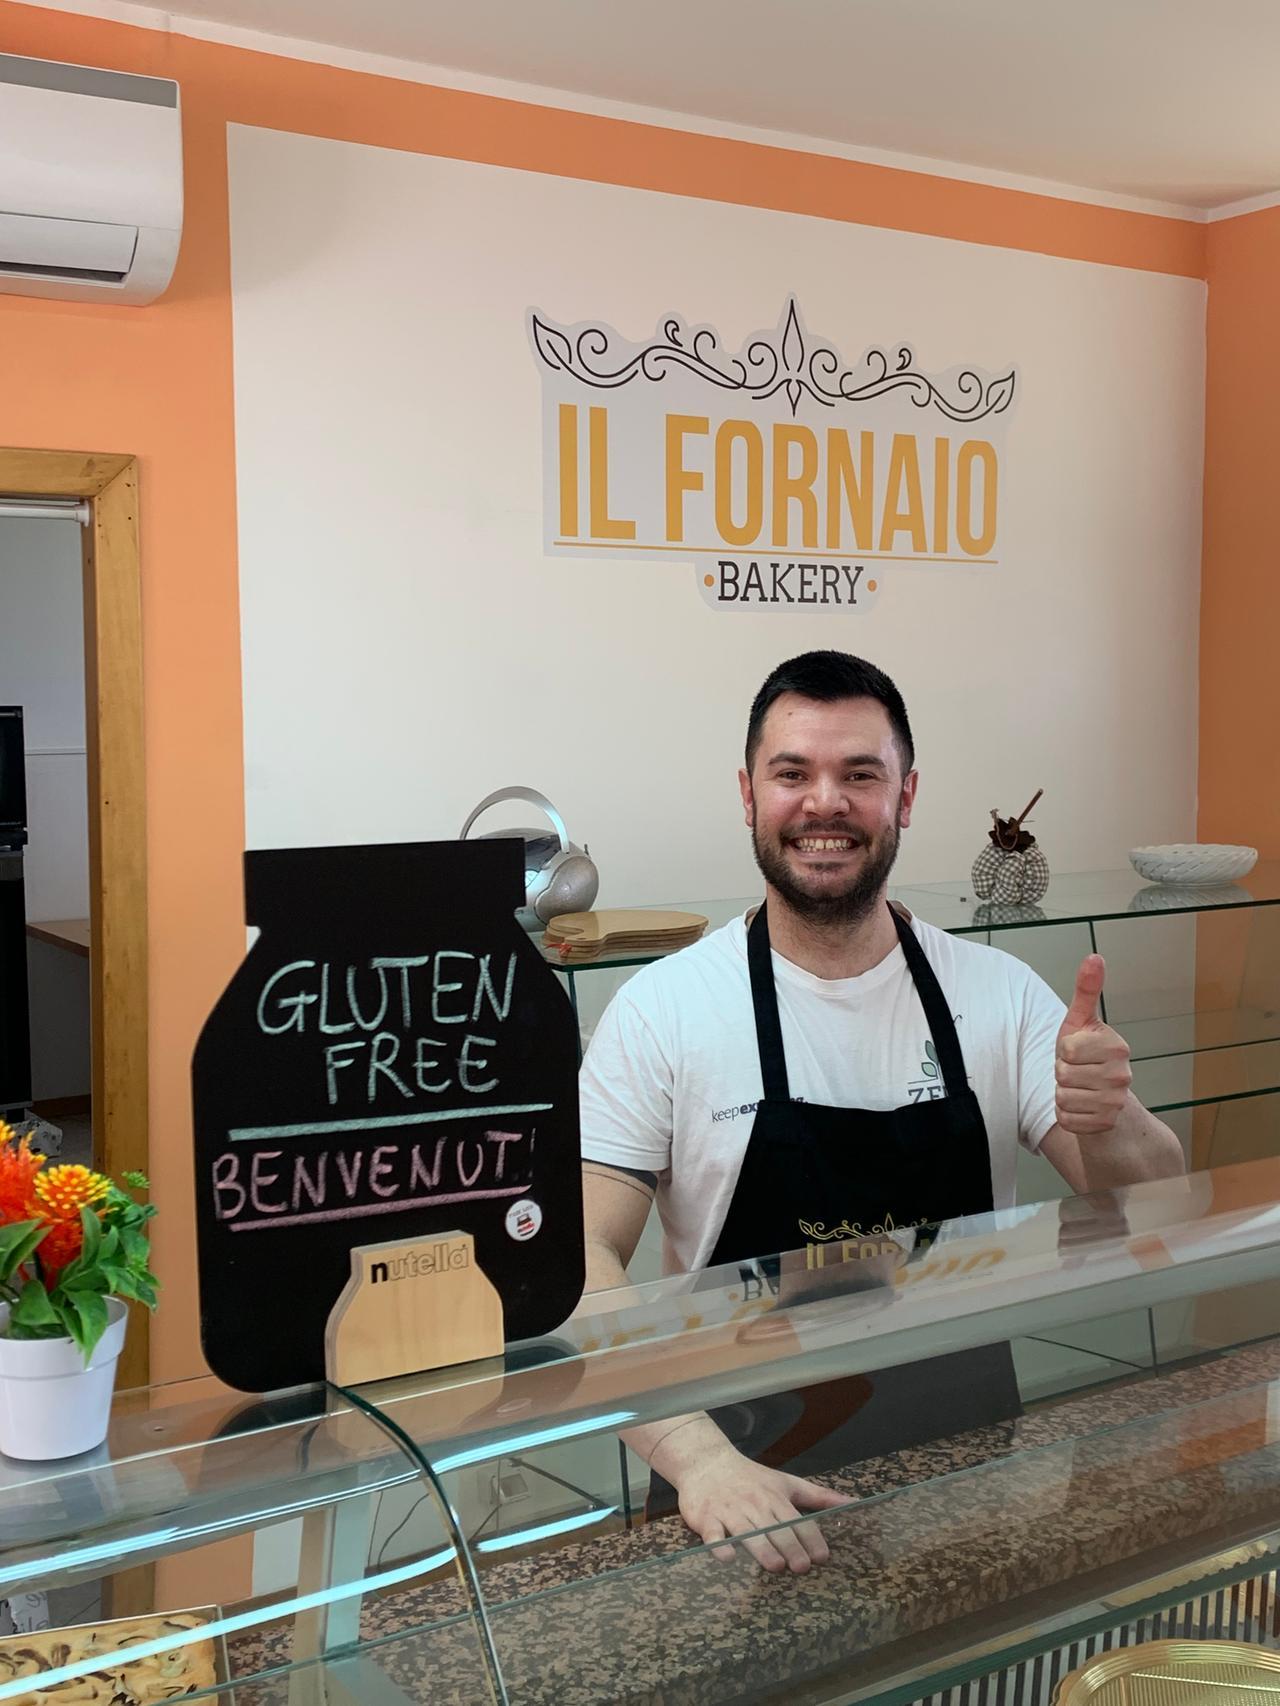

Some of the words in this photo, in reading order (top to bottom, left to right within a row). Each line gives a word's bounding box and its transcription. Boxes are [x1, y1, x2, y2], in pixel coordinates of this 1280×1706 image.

[559, 403, 636, 539] IL
[665, 413, 998, 556] FORNAIO
[717, 560, 864, 605] BAKERY
[256, 950, 519, 1035] GLUTEN
[324, 1032, 500, 1105] FREE
[371, 1242, 470, 1284] nutella
